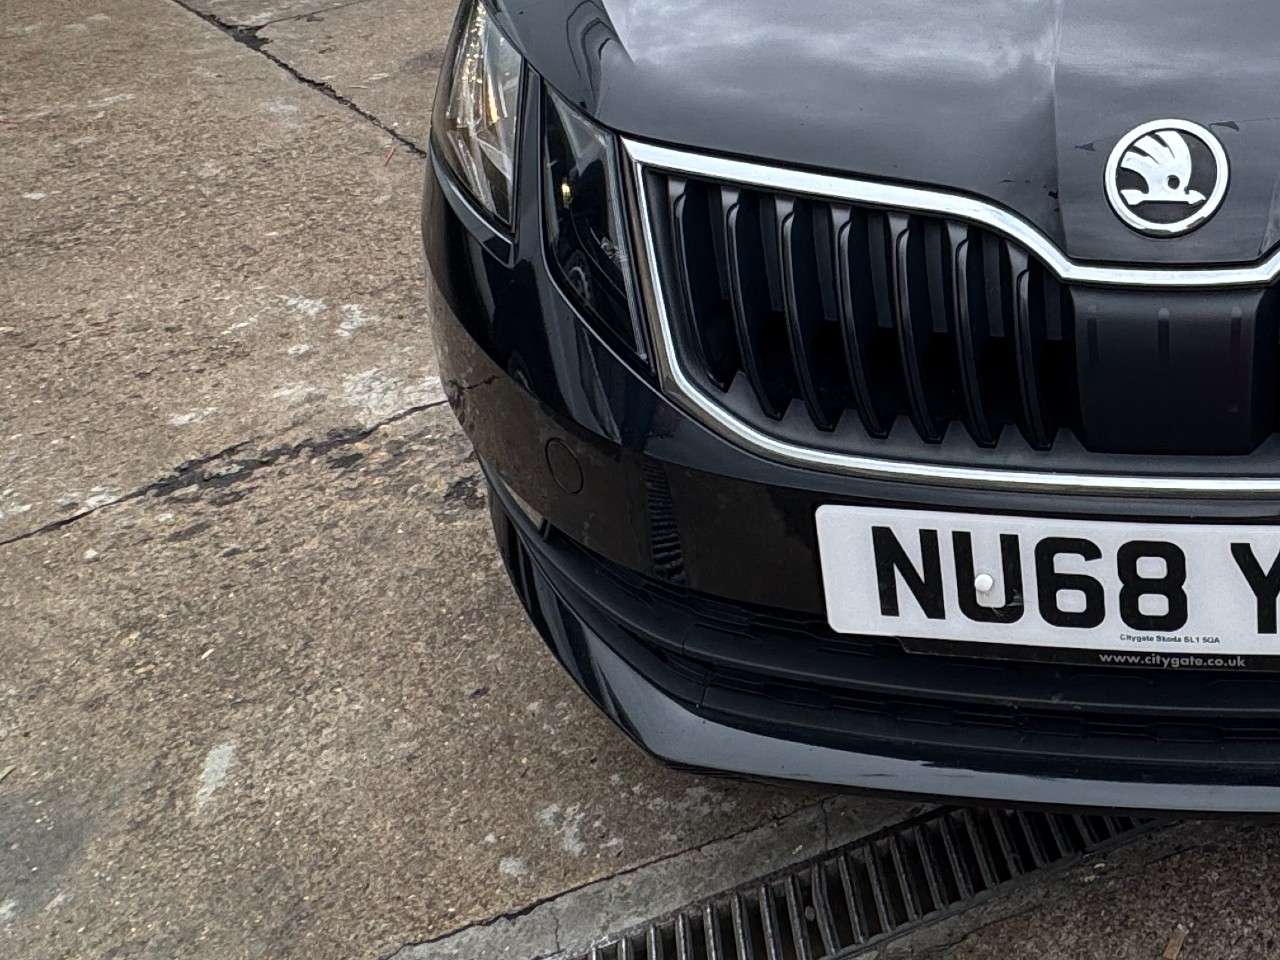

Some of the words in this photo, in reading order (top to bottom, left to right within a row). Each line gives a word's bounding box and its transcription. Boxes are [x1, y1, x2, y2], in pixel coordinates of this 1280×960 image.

[870, 525, 1190, 632] NU68
[1120, 634, 1154, 642] Citygate
[1099, 653, 1246, 668] www.citygate.co.uk
